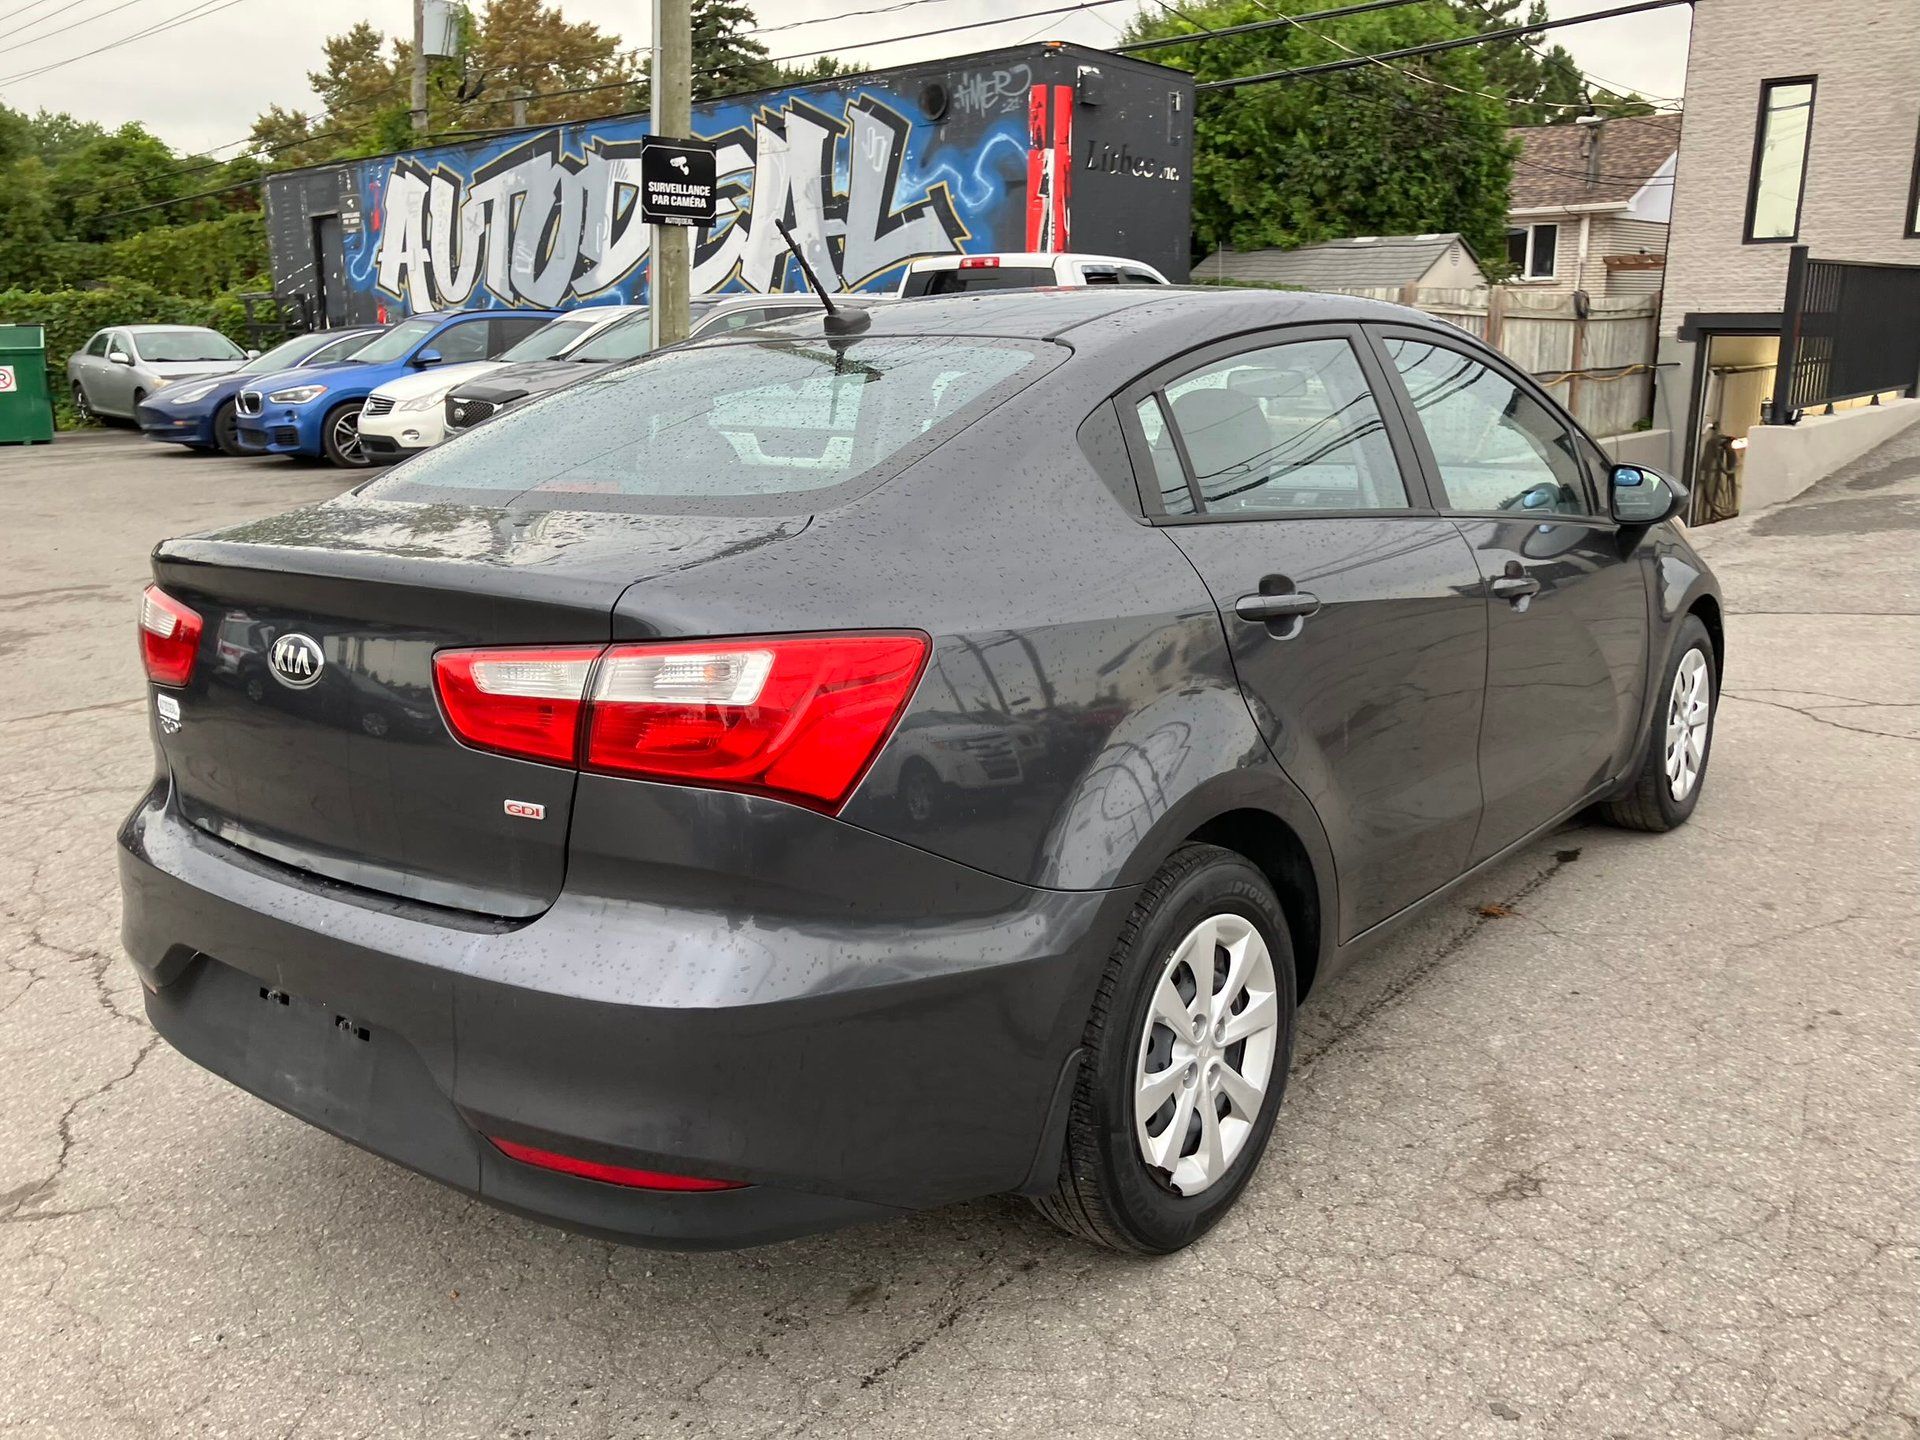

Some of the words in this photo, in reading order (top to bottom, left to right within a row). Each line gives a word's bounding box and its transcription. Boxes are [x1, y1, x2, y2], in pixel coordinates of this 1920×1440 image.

[648, 181, 711, 196] SURVEILLANCE
[652, 194, 669, 206] PAR
[670, 195, 707, 208] CAMÉRA
[275, 642, 312, 675] KIA
[507, 804, 540, 817] GDI
